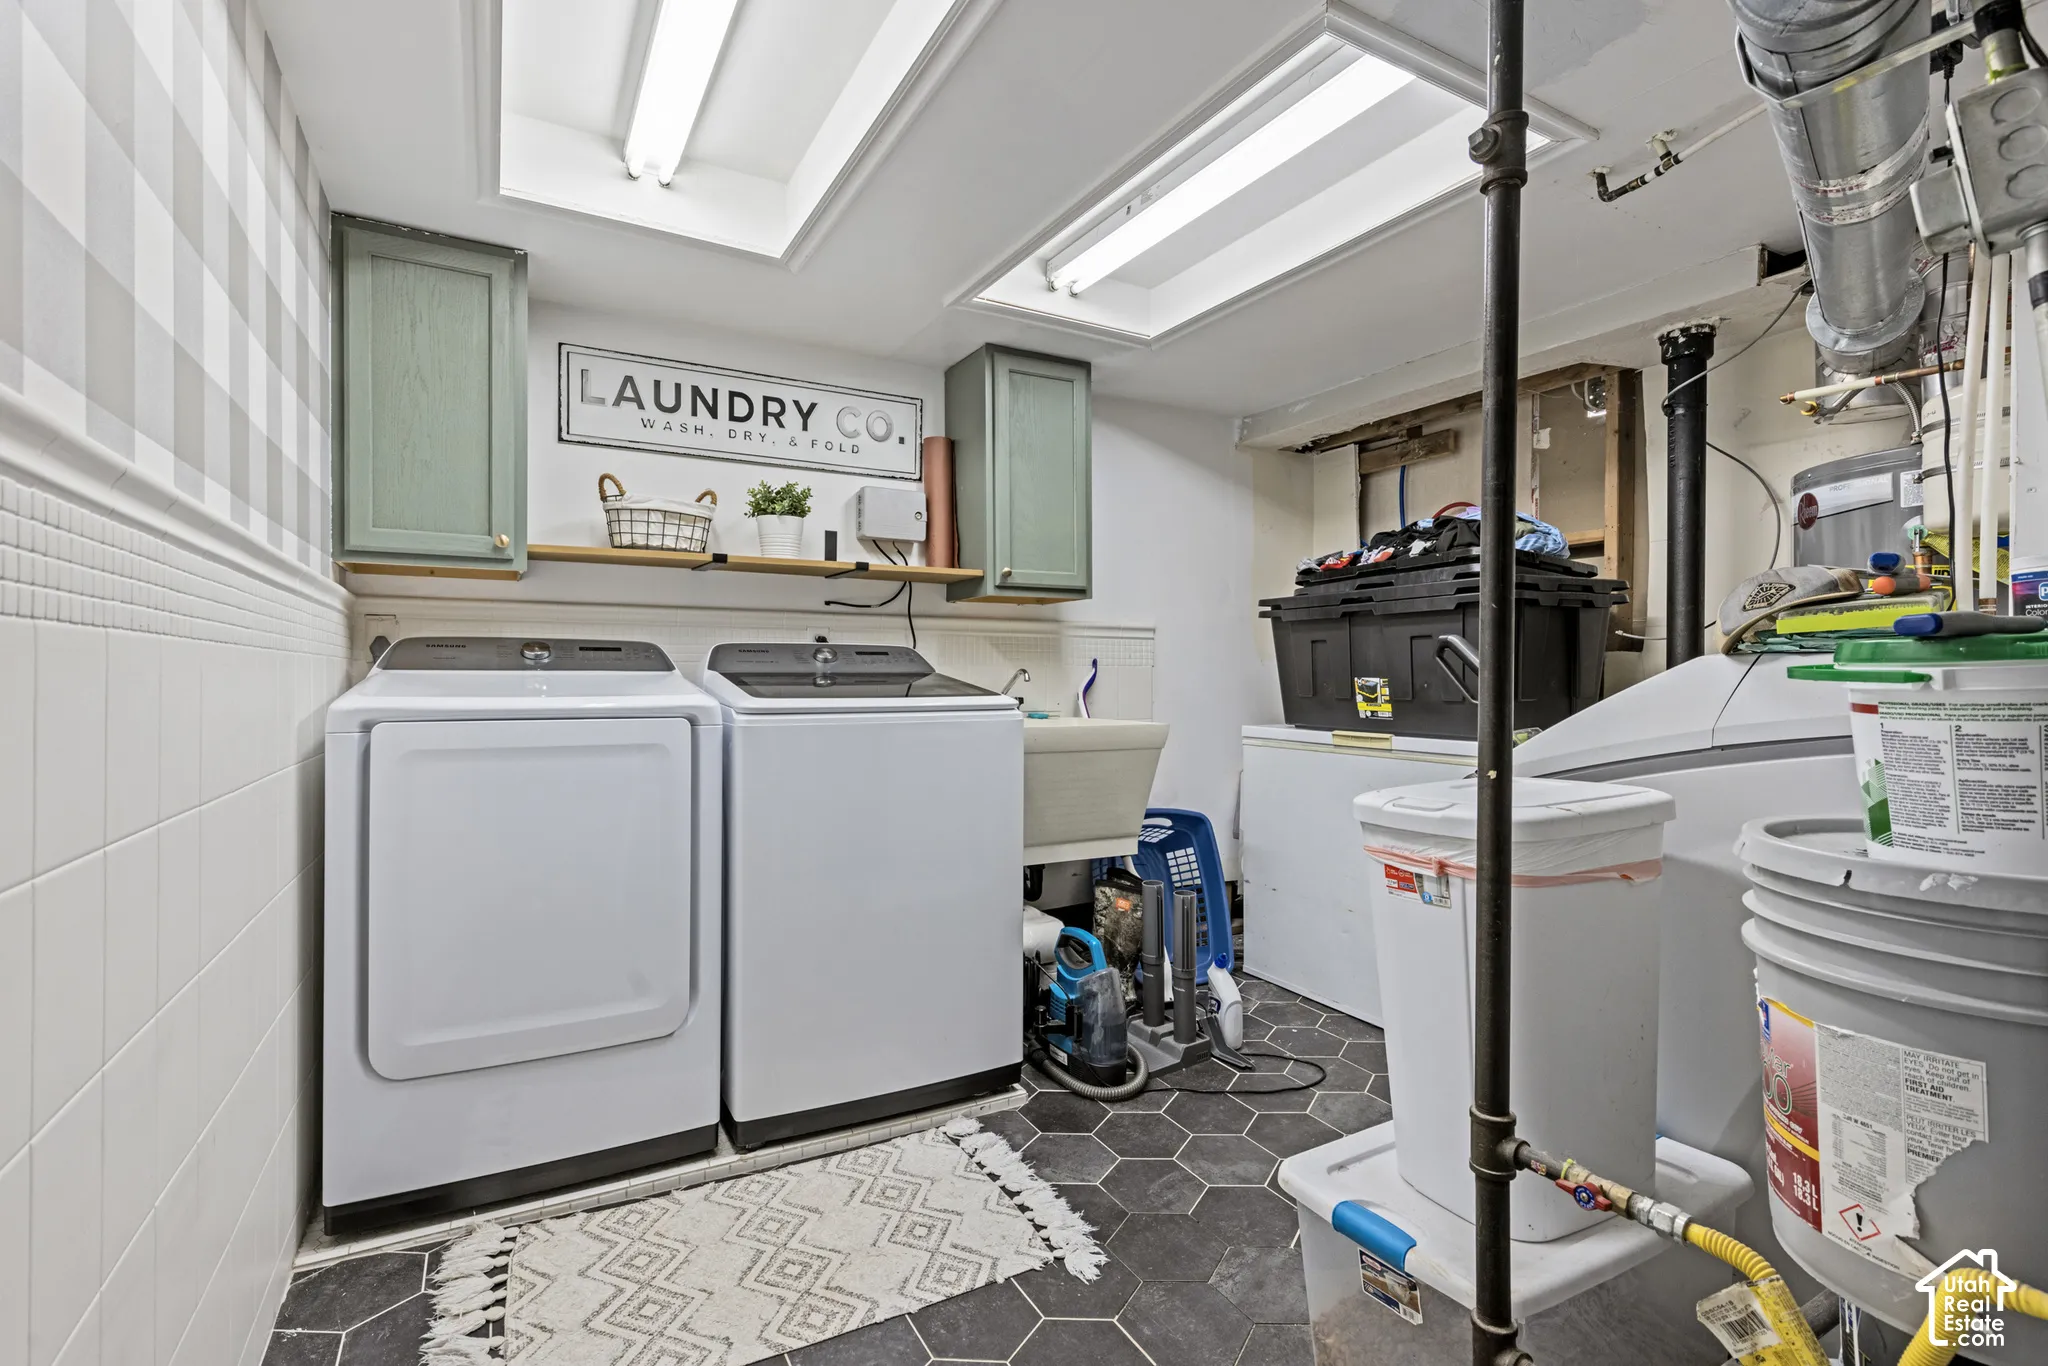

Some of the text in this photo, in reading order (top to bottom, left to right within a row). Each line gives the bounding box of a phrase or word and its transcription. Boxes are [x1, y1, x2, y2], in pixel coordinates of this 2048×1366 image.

[581, 368, 905, 445] LAUNDRY CO.
[788, 436, 798, 447] &
[811, 439, 860, 455] FOLD
[1904, 1050, 1960, 1069] MAY IRRITATE
[1904, 1058, 1980, 1080] EYES. Do not get in
[1904, 1065, 1922, 1075] eyes.
[1926, 1070, 1945, 1080] Keep
[1946, 1074, 1960, 1082] out
[1904, 1072, 1971, 1092] reach of children.
[1904, 1078, 1944, 1093] FIRST AID
[1905, 1084, 1956, 1103] TREATMENT.
[1906, 1114, 1976, 1138] PEUT IRRITER LES
[1906, 1128, 1932, 1140] contact
[1934, 1136, 1952, 1146] avec
[1952, 1134, 1968, 1143] tout
[1812, 1183, 1818, 1198] L
[1812, 1197, 1819, 1212] L
